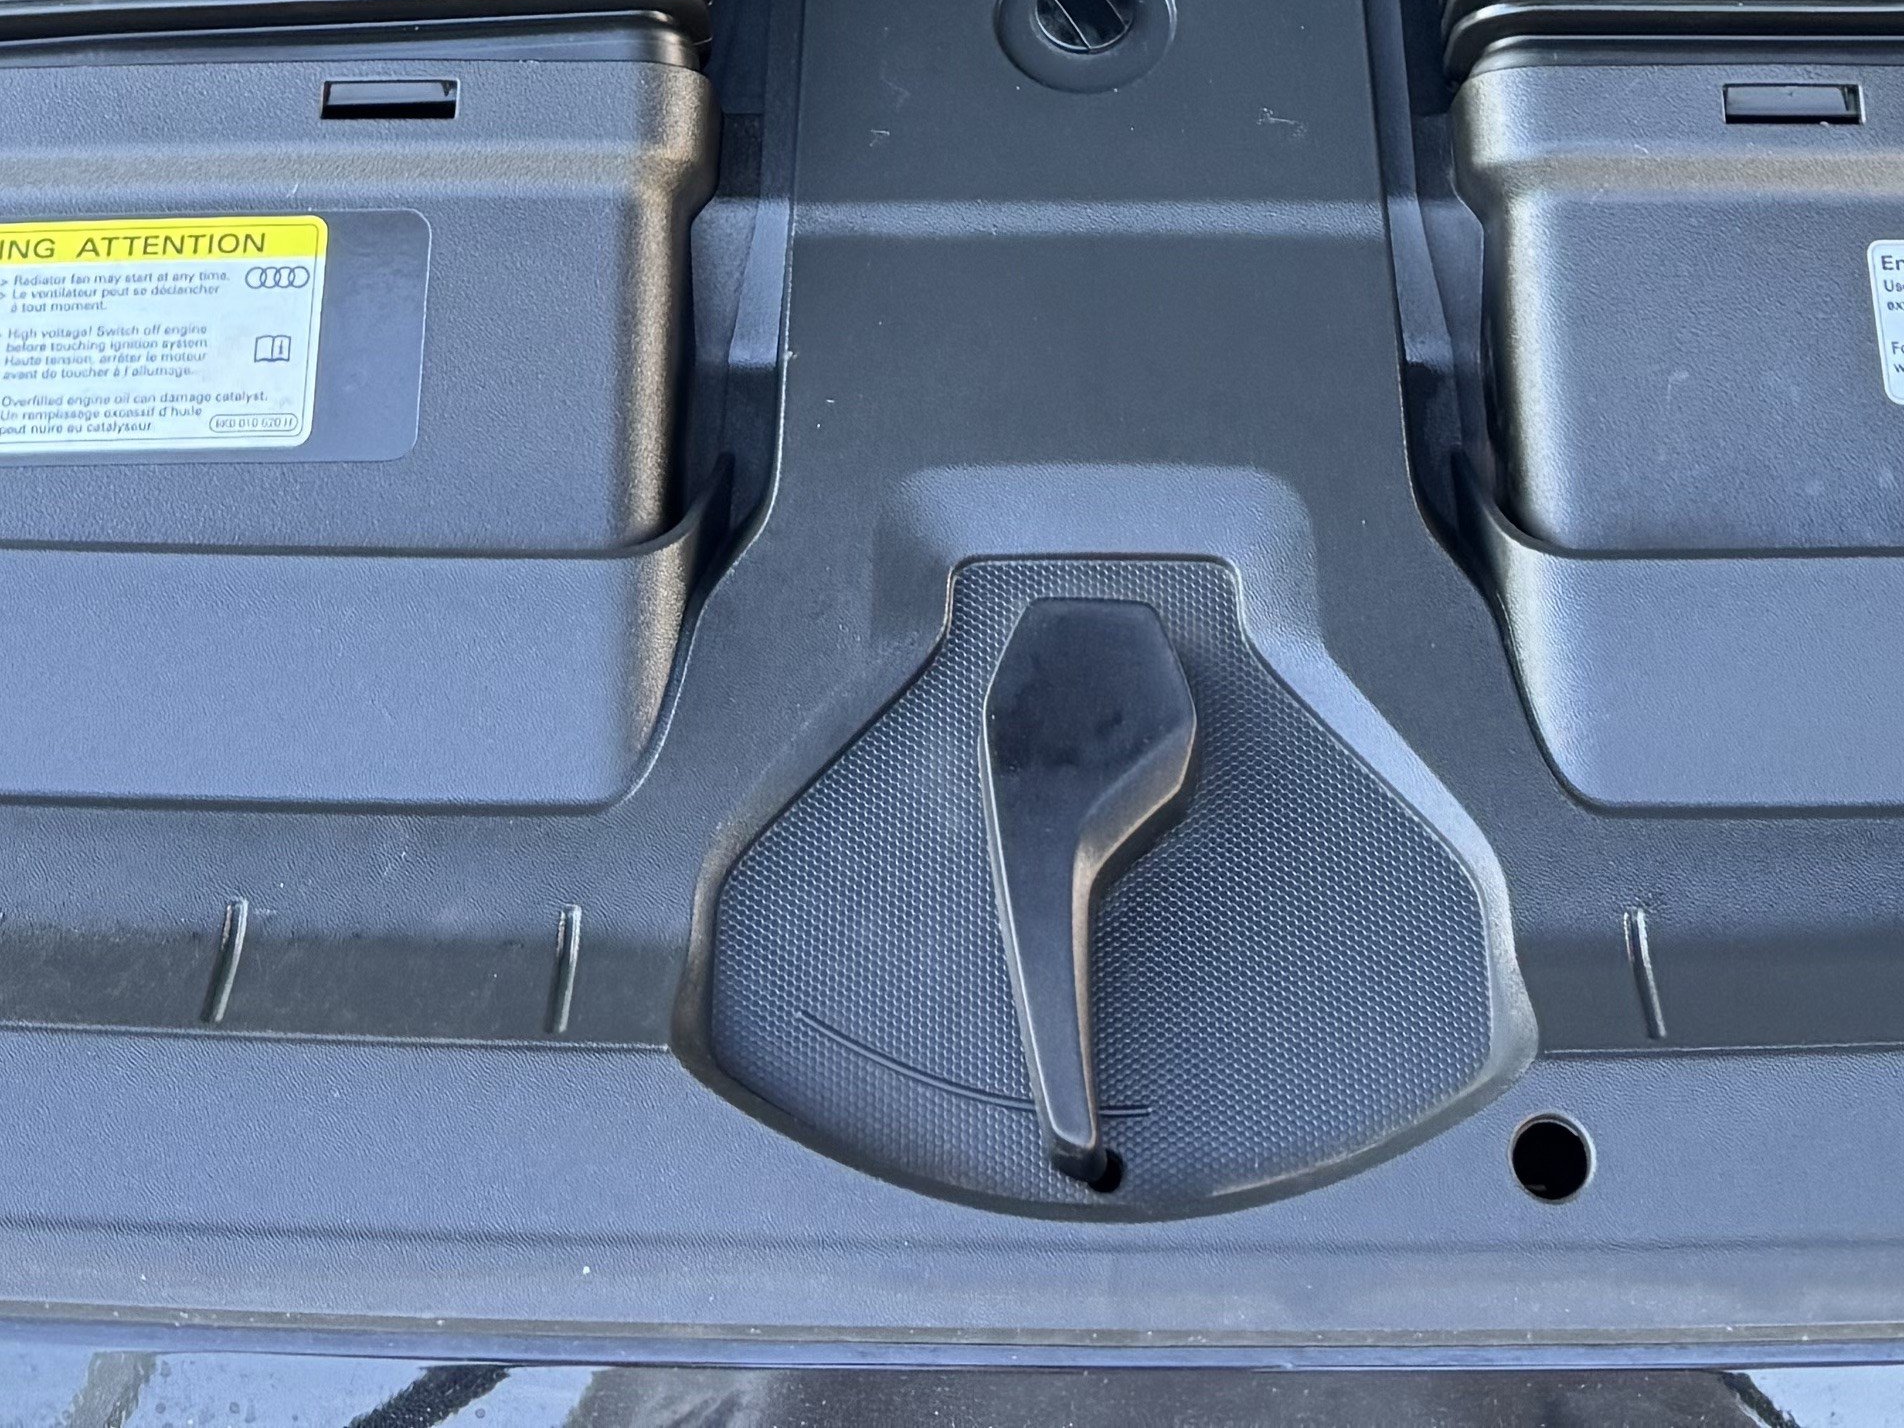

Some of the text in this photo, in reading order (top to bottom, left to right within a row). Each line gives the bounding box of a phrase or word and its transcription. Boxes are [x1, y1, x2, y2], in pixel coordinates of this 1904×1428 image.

[76, 233, 267, 258] ATTENTION
[13, 275, 66, 286] Radiator
[70, 273, 90, 285] fan
[94, 274, 121, 286] may
[125, 273, 152, 284] start
[157, 272, 169, 283] at
[173, 273, 194, 284] any
[12, 288, 27, 299] Le
[31, 287, 97, 299] ventilateur
[101, 286, 129, 299] peut
[22, 302, 46, 312] tout
[8, 327, 37, 342] High
[97, 325, 138, 338] Switch
[143, 324, 161, 335] off
[164, 325, 207, 338] engine
[5, 338, 208, 353] before touching ignition system
[160, 351, 206, 363] moteur
[61, 366, 109, 379] toucher
[1, 394, 64, 408] Overfilled
[67, 394, 110, 408] engine
[114, 392, 130, 404] oil
[133, 394, 157, 404] can
[160, 391, 212, 405] damage
[30, 423, 63, 434] nuire
